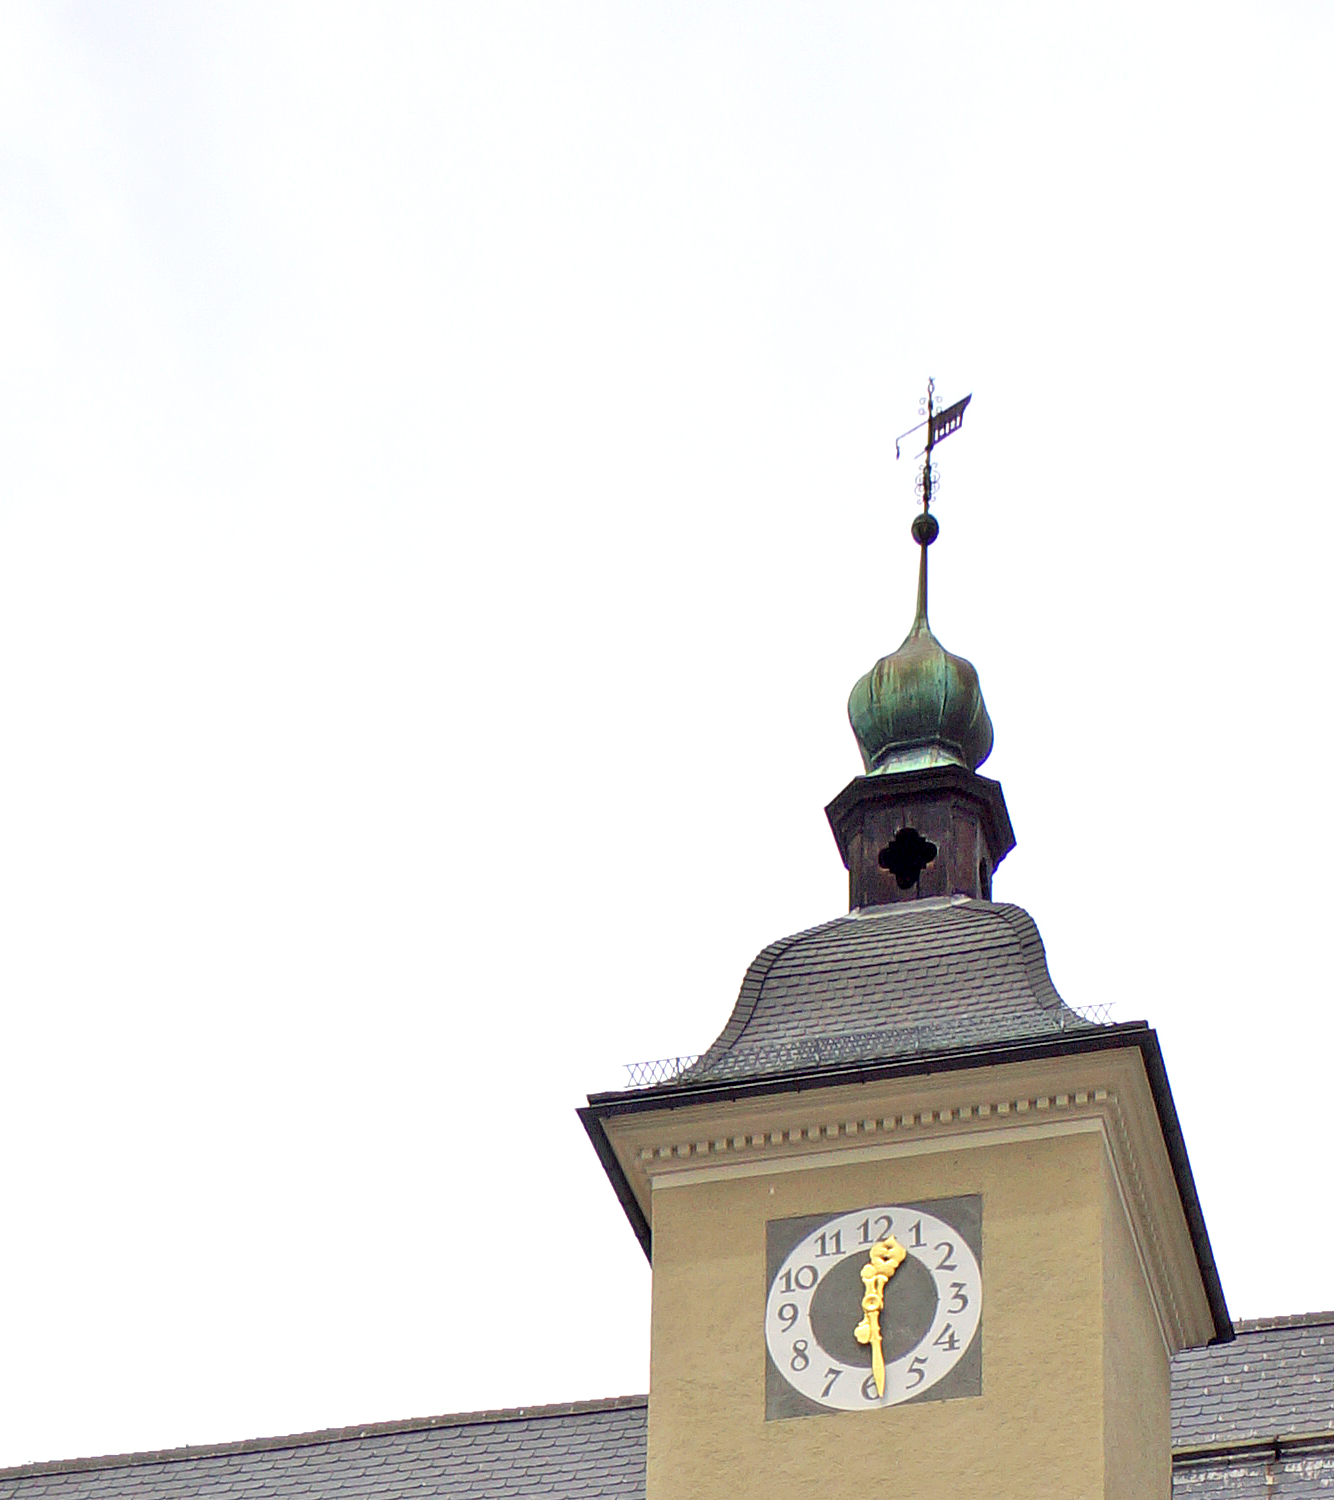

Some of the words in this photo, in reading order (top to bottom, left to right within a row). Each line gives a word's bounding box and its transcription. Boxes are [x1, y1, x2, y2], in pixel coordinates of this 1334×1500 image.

[814, 1229, 846, 1258] 11
[857, 1215, 896, 1245] 12
[908, 1220, 926, 1248] 1
[934, 1242, 958, 1272] 2
[779, 1265, 819, 1293] 10
[948, 1282, 968, 1314] 3
[778, 1303, 799, 1333] 9
[932, 1322, 960, 1351] 4
[790, 1339, 809, 1372] 8
[821, 1367, 843, 1398] 7
[861, 1372, 884, 1400] 6
[905, 1356, 929, 1389] 5
